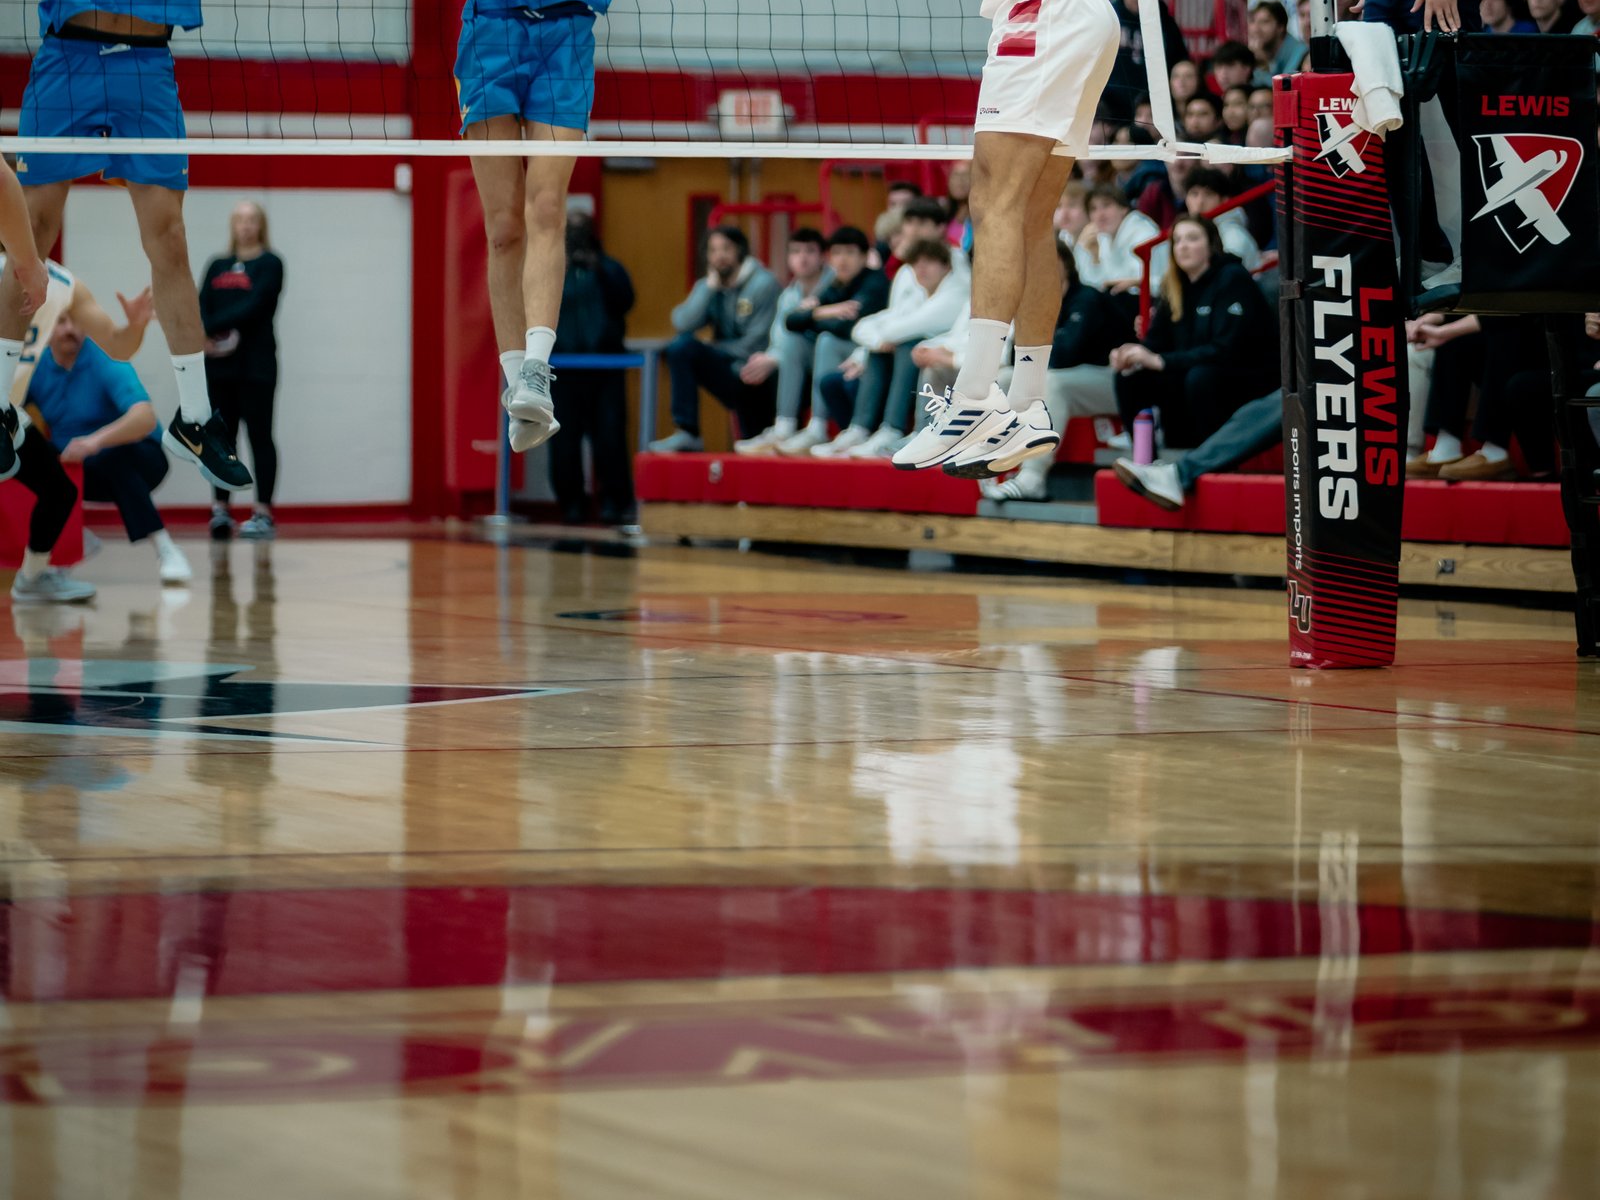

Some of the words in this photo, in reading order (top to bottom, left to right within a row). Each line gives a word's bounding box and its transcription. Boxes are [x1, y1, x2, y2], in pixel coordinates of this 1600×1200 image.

[1319, 97, 1358, 111] LEW
[1481, 95, 1570, 118] LEWIS
[1311, 253, 1360, 521] FLYERS
[1359, 286, 1399, 487] LEWIS
[1291, 427, 1301, 488] sports
[1293, 493, 1303, 571] imports
